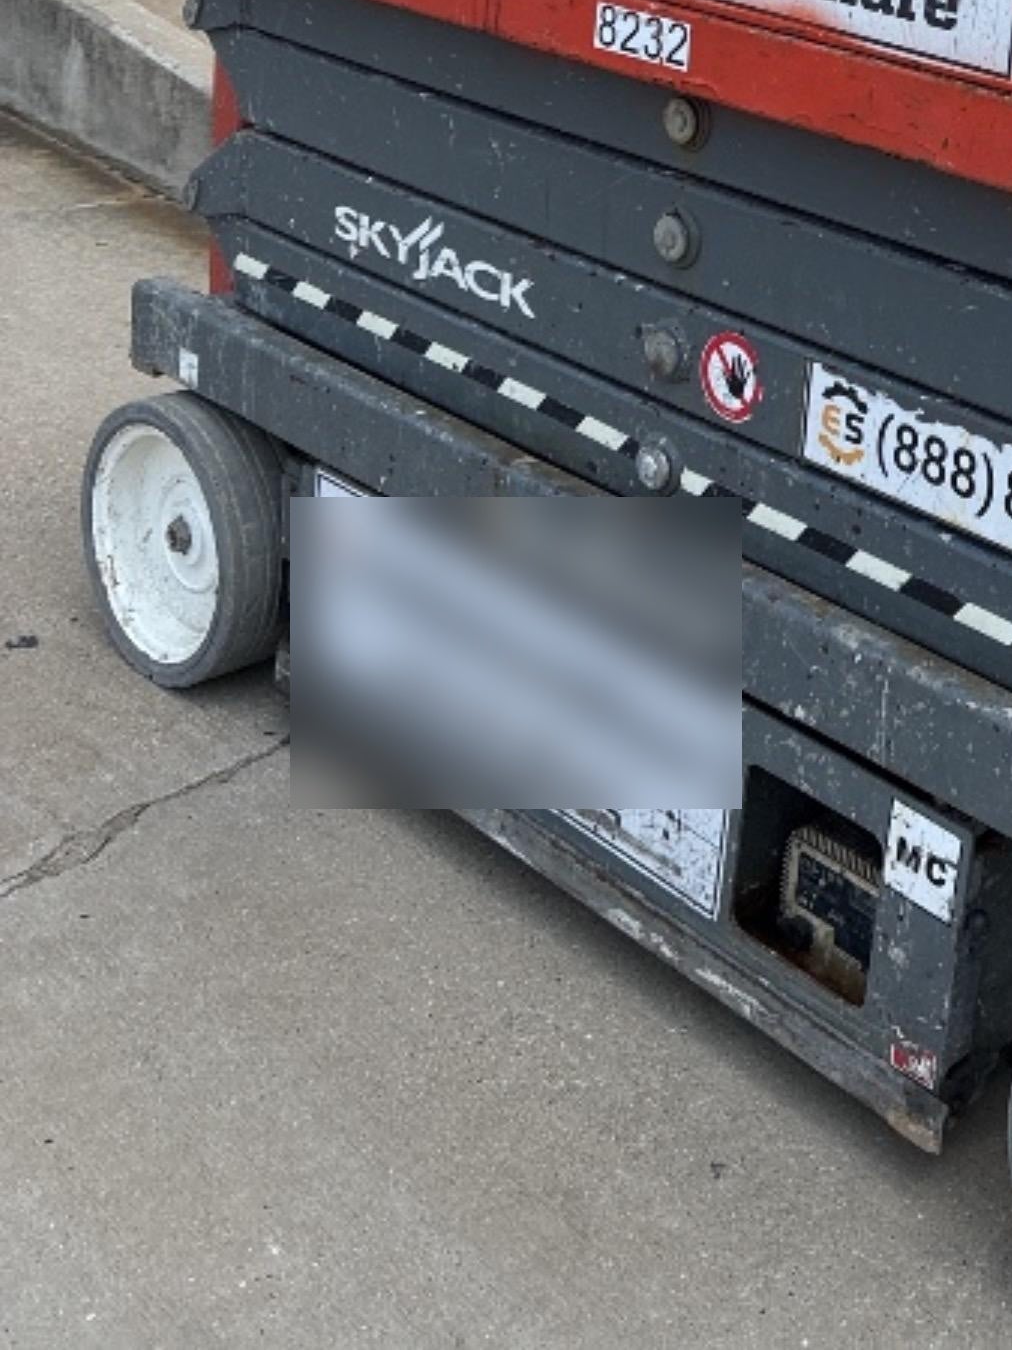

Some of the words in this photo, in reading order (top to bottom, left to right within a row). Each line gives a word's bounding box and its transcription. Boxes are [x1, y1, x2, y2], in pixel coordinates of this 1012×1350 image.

[597, 5, 690, 67] 8232
[333, 205, 536, 319] SKYJACK
[896, 836, 949, 887] MC
